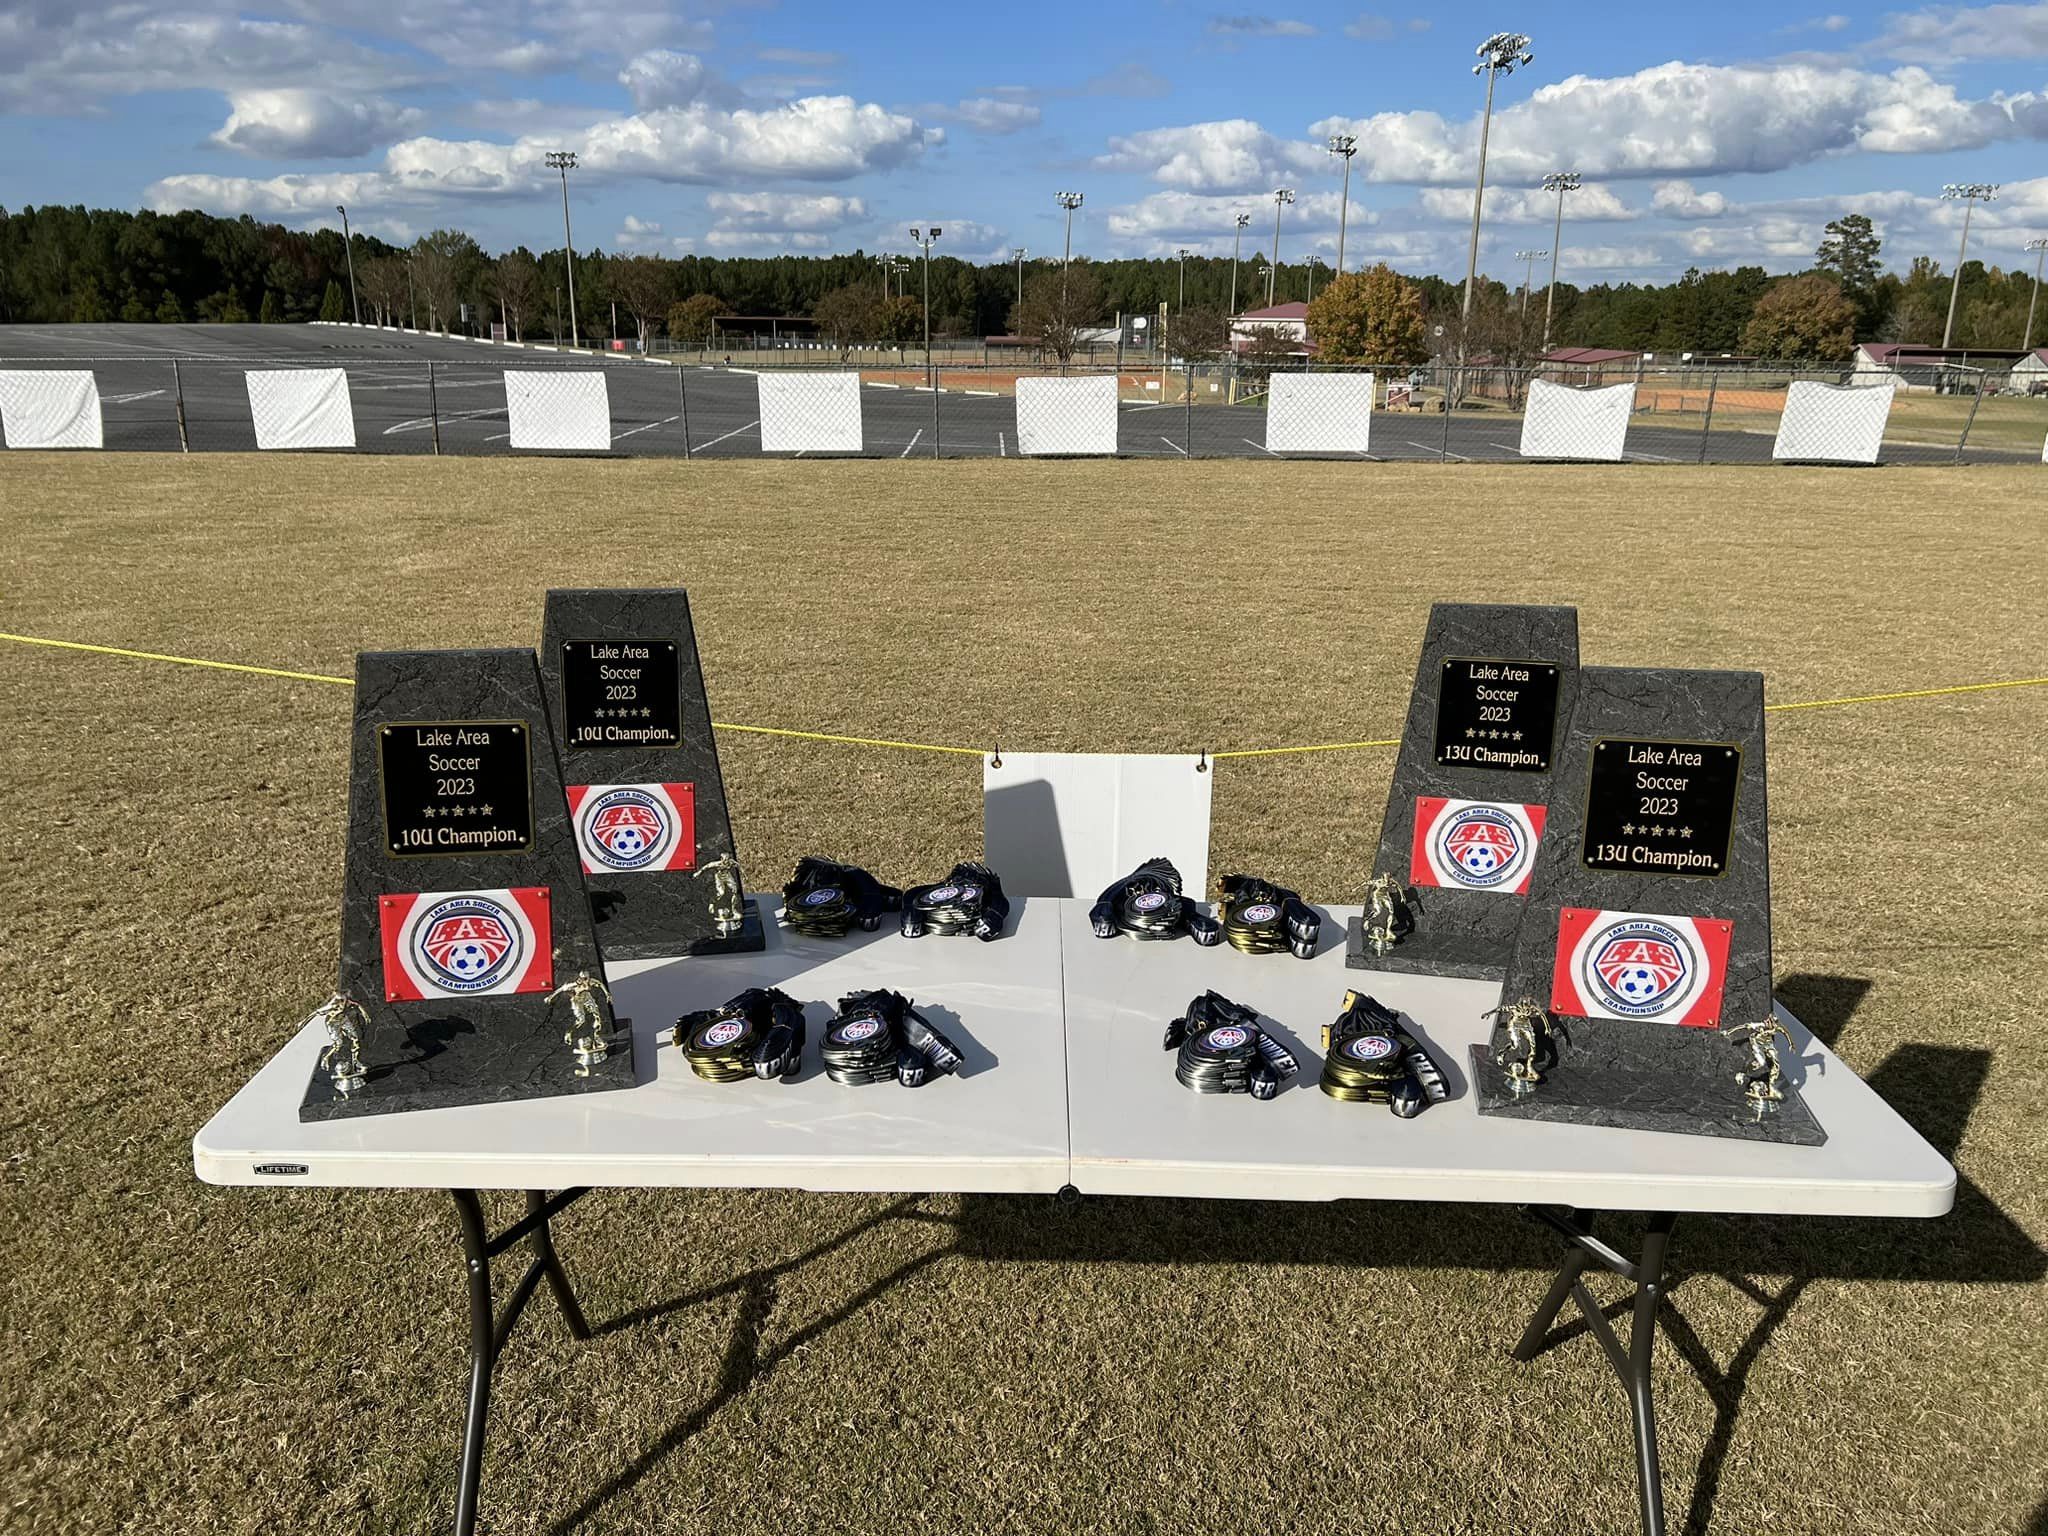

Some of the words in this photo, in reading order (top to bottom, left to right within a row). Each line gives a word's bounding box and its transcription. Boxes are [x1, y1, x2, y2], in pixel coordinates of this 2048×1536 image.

[591, 644, 619, 659] Lake
[622, 644, 649, 659] Area
[600, 665, 641, 680] Soccer
[1469, 664, 1498, 680] Lake
[1501, 666, 1529, 681] Area
[606, 685, 637, 700] 2023
[1476, 685, 1519, 702] Soccer
[1479, 706, 1511, 721] 2023
[417, 729, 452, 746] Lake
[456, 728, 490, 746] Area
[577, 726, 602, 741] 10U
[606, 725, 669, 744] Champion
[429, 754, 480, 771] Soccer
[1445, 745, 1471, 760] 13U
[1474, 747, 1539, 767] Champion
[1628, 745, 1664, 765] Lake
[1667, 748, 1702, 766] Area
[436, 778, 475, 795] 2023
[1636, 771, 1688, 791] Soccer
[1640, 797, 1678, 815] 2023
[401, 828, 433, 846] 10U
[437, 826, 517, 847] Champion
[1597, 844, 1628, 862] 13U
[1632, 846, 1712, 870] Champion
[430, 905, 447, 919] LAKE
[472, 901, 501, 916] SOCCER
[1607, 925, 1627, 938] LAKE
[1652, 925, 1680, 943] SOCCER
[437, 974, 499, 990] CHAMPIONSHIP
[1603, 997, 1665, 1014] CHAMPIONSHIP
